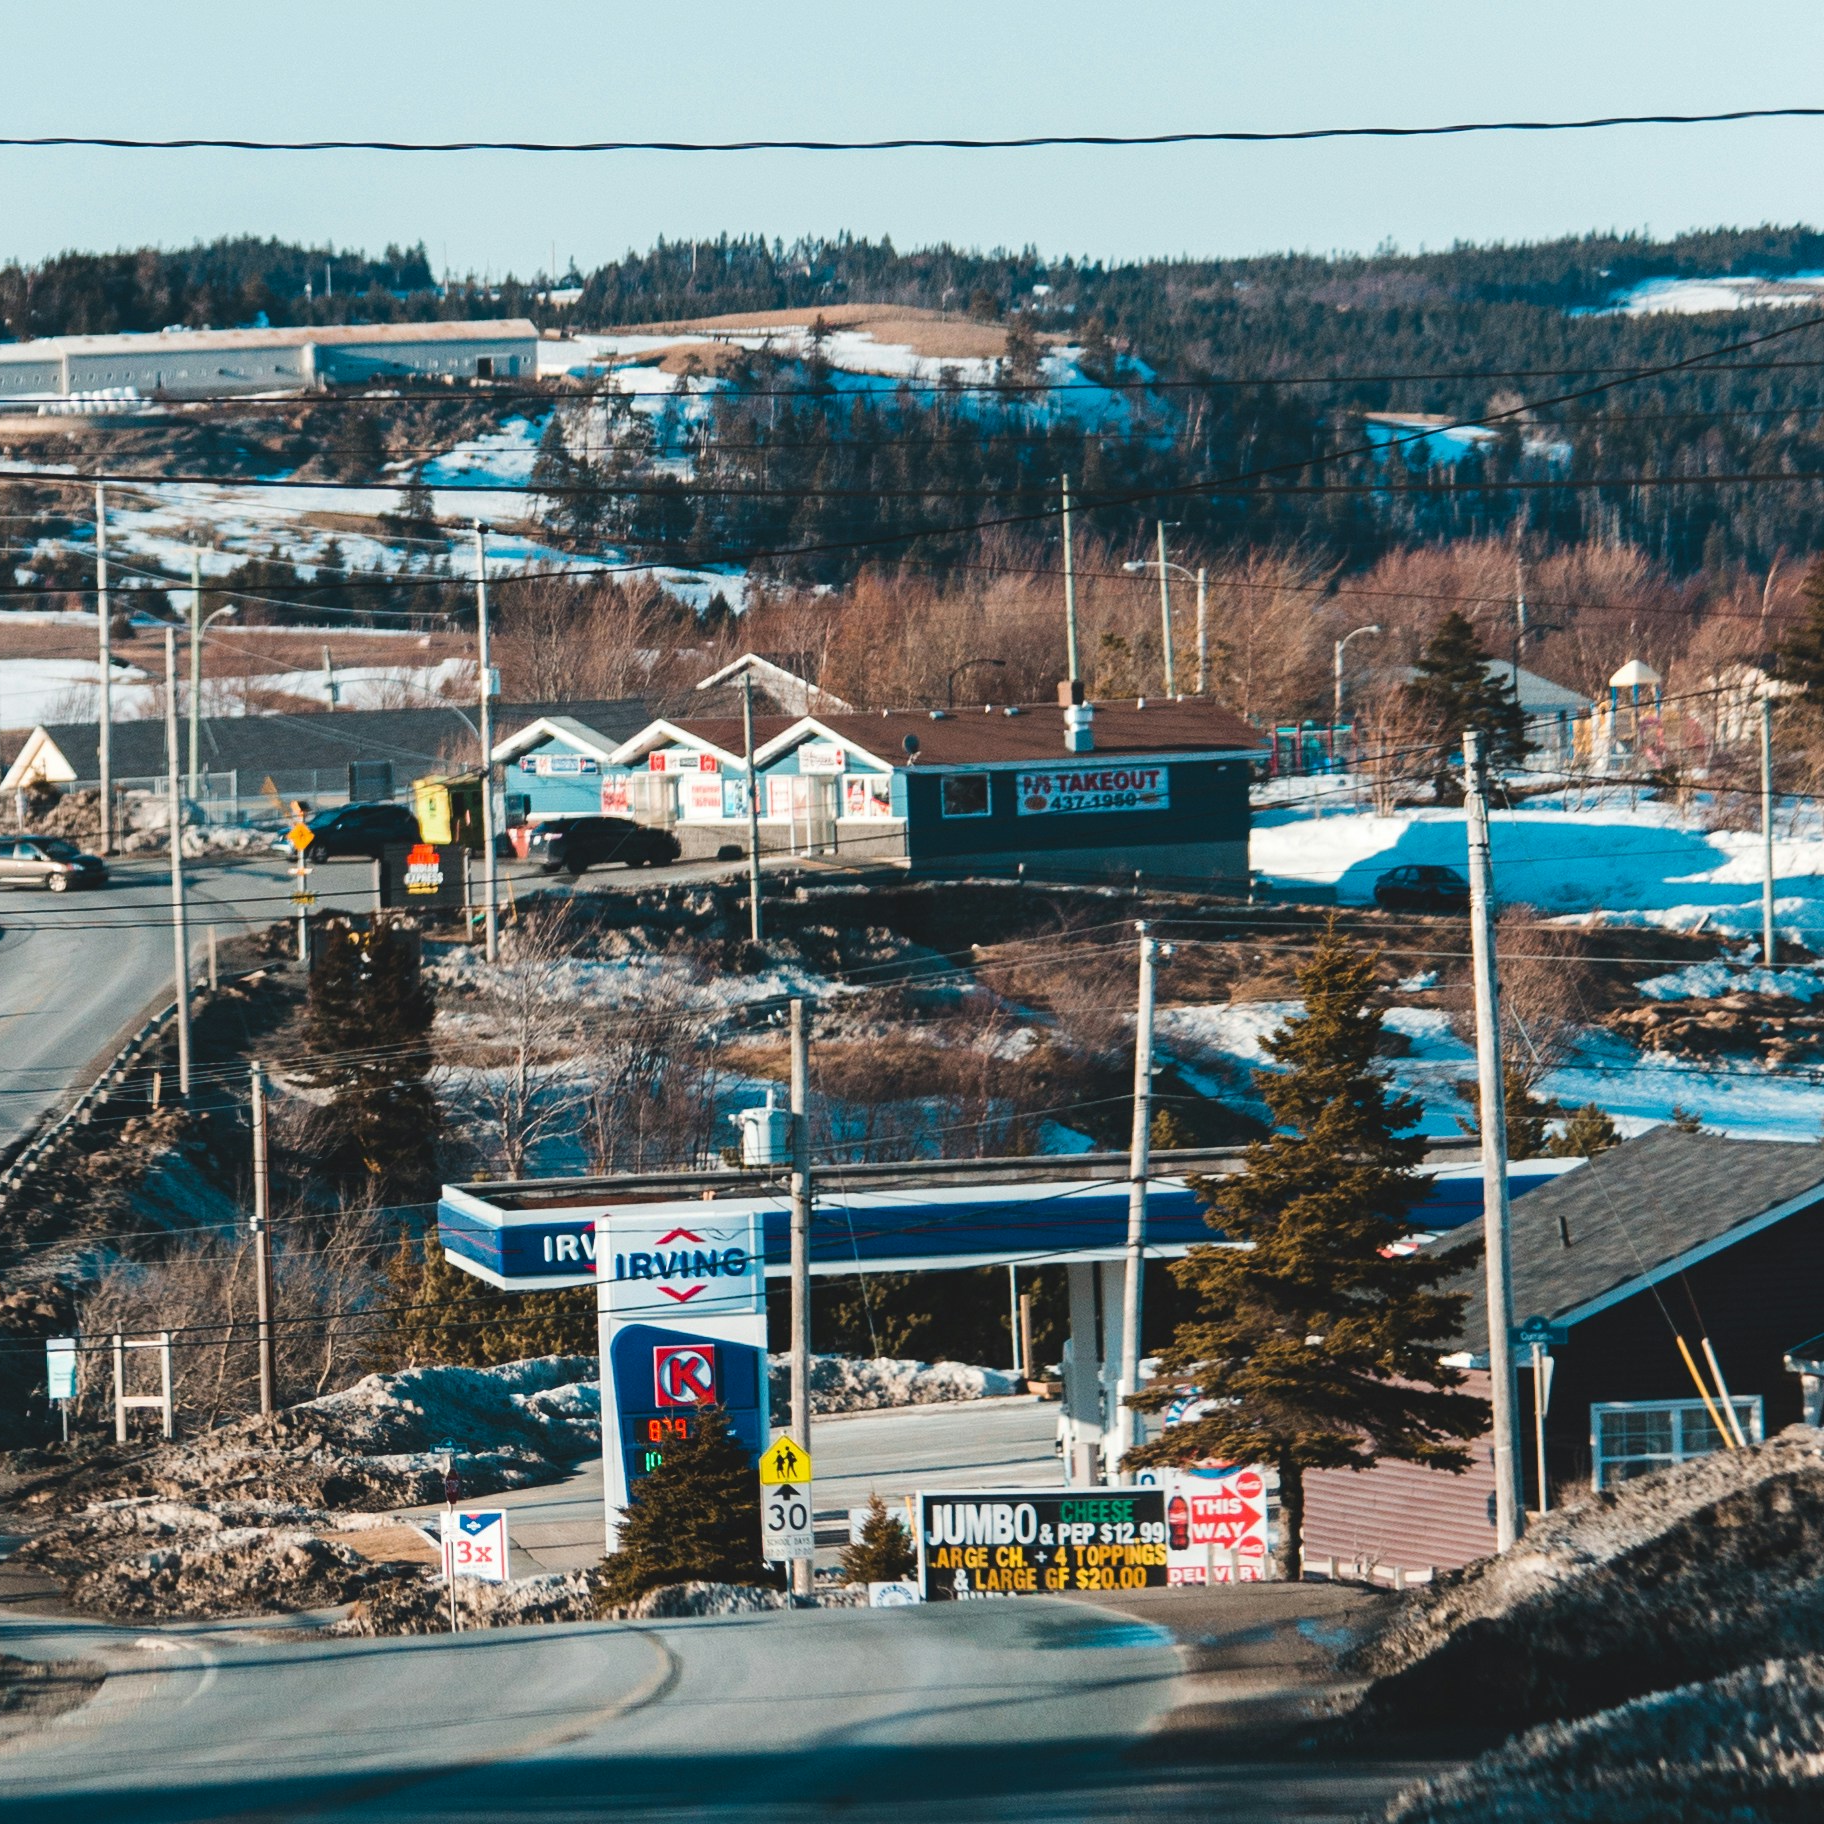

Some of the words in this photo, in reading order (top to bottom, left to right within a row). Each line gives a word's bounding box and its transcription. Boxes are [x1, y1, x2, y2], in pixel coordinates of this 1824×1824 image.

[1056, 770, 1160, 792] TAKEOUT
[615, 1248, 746, 1281] IRVING
[669, 1356, 713, 1403] K
[768, 1503, 807, 1531] 30
[1061, 1501, 1134, 1523] CHEESE
[1194, 1498, 1242, 1515] THIS
[925, 1503, 1037, 1545] JUMBO
[1039, 1523, 1054, 1545] &
[1058, 1523, 1095, 1545] PEP
[1099, 1522, 1164, 1544] $12.99
[1193, 1522, 1245, 1539] WAY
[996, 1546, 1028, 1568] CH.
[1054, 1546, 1068, 1566] 4
[1073, 1543, 1166, 1567] TOPPINGS
[953, 1568, 969, 1591] &
[976, 1567, 1038, 1590] LARGE
[1045, 1567, 1069, 1590] GF
[1076, 1567, 1146, 1590] $20.00
